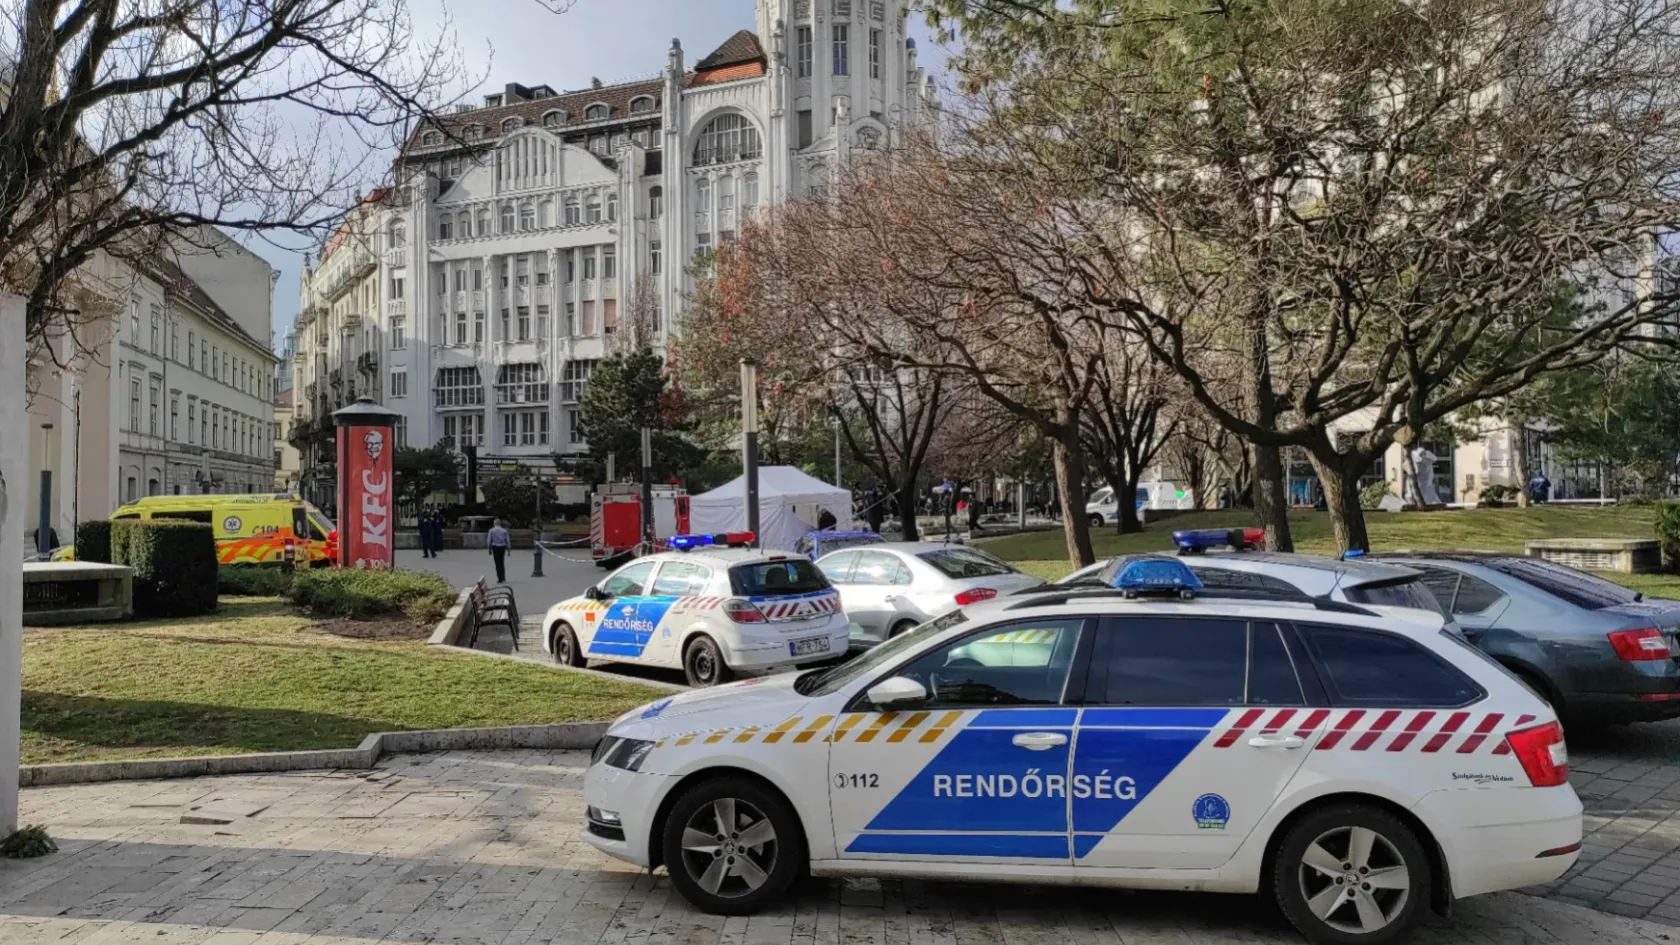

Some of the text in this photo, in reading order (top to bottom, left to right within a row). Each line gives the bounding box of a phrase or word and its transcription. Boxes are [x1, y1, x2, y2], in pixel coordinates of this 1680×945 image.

[362, 468, 387, 547] KFC
[261, 525, 280, 534] 104
[603, 616, 654, 632] RENDŐRSÉG
[849, 773, 880, 789] 112
[933, 768, 1137, 800] RENDŐRSÉG
